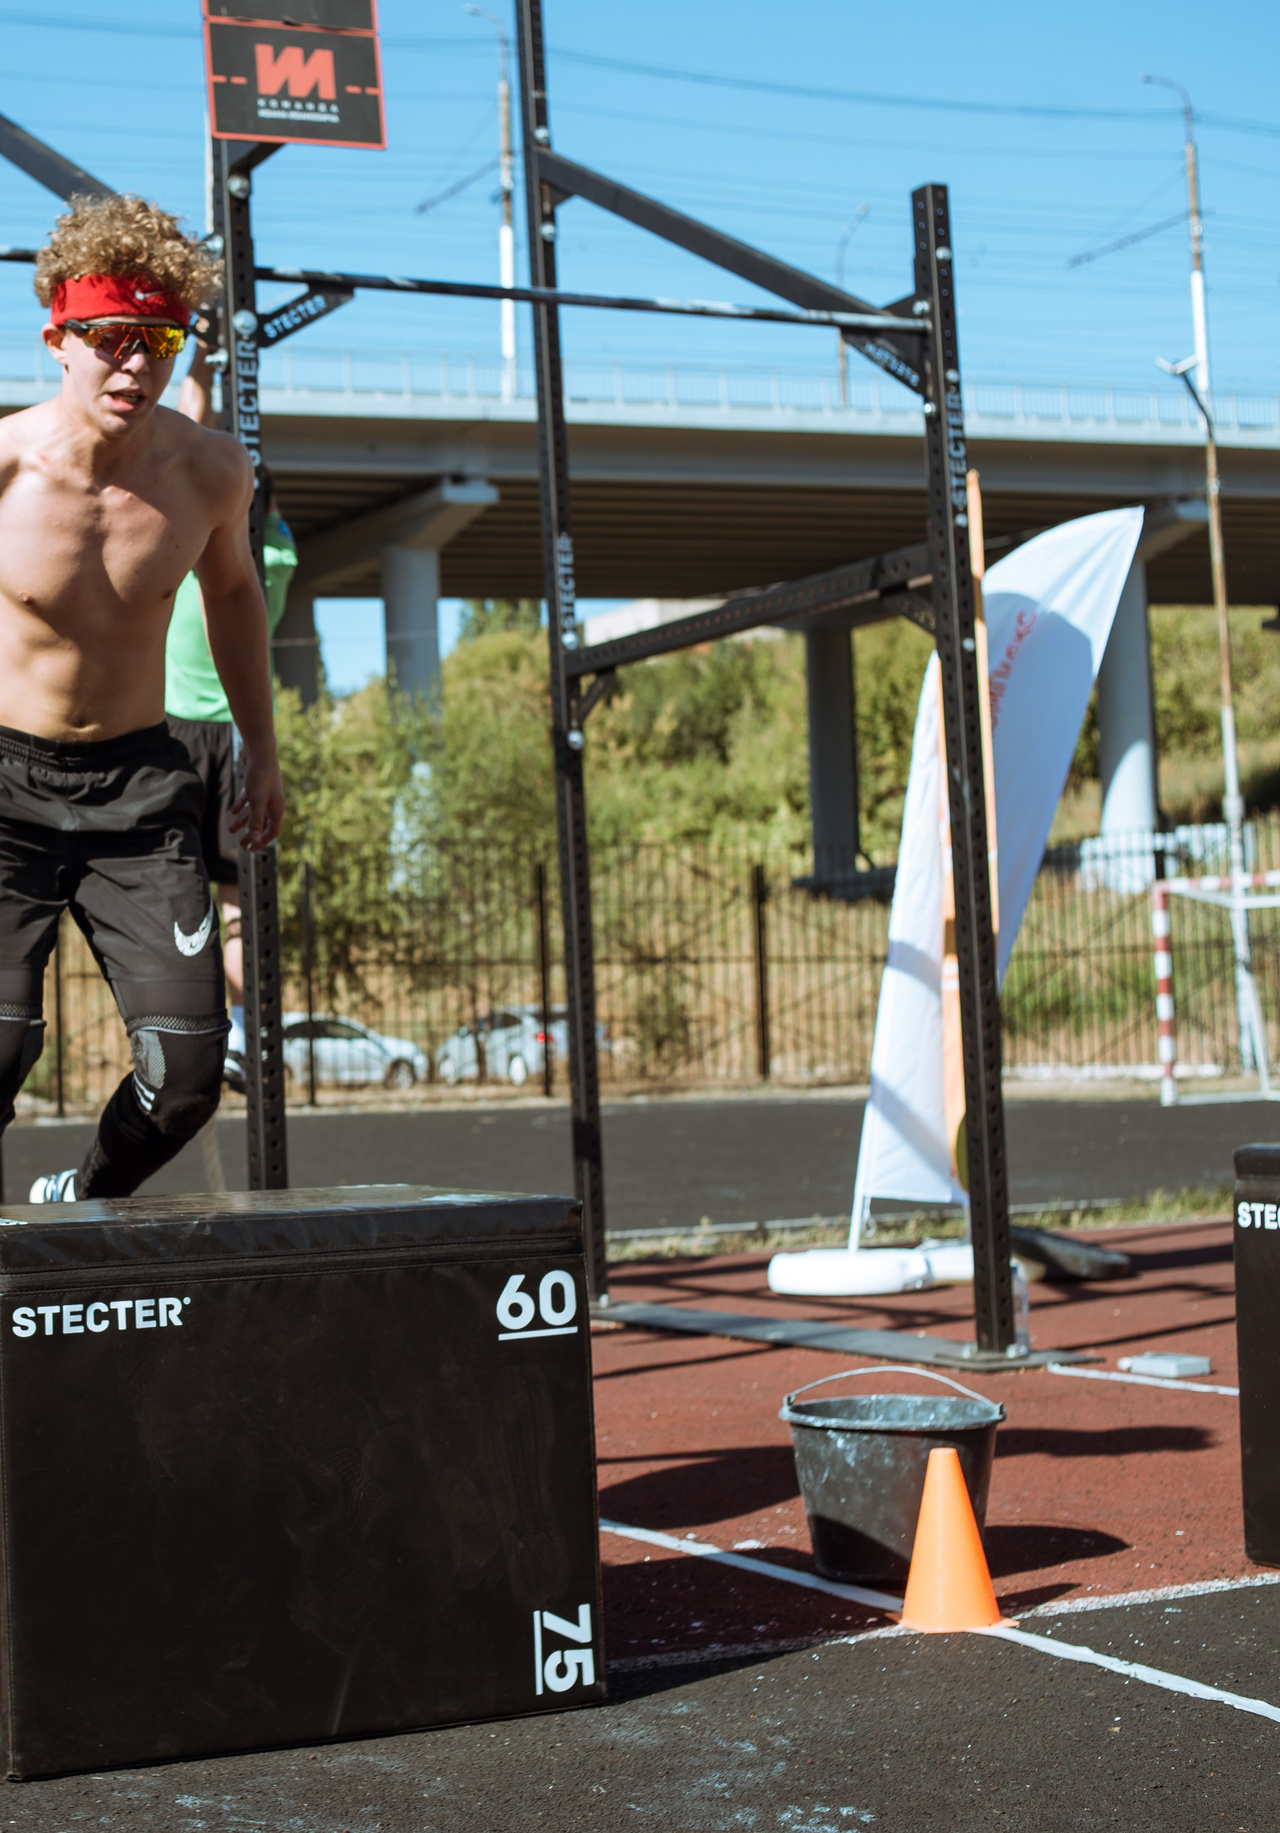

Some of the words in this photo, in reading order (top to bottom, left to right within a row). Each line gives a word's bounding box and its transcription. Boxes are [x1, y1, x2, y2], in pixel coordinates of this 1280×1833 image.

[263, 294, 327, 338] STECTER
[1237, 1201, 1280, 1230] STE
[12, 1297, 184, 1338] STECTER
[496, 1269, 577, 1330] 60
[542, 1603, 595, 1693] 75
